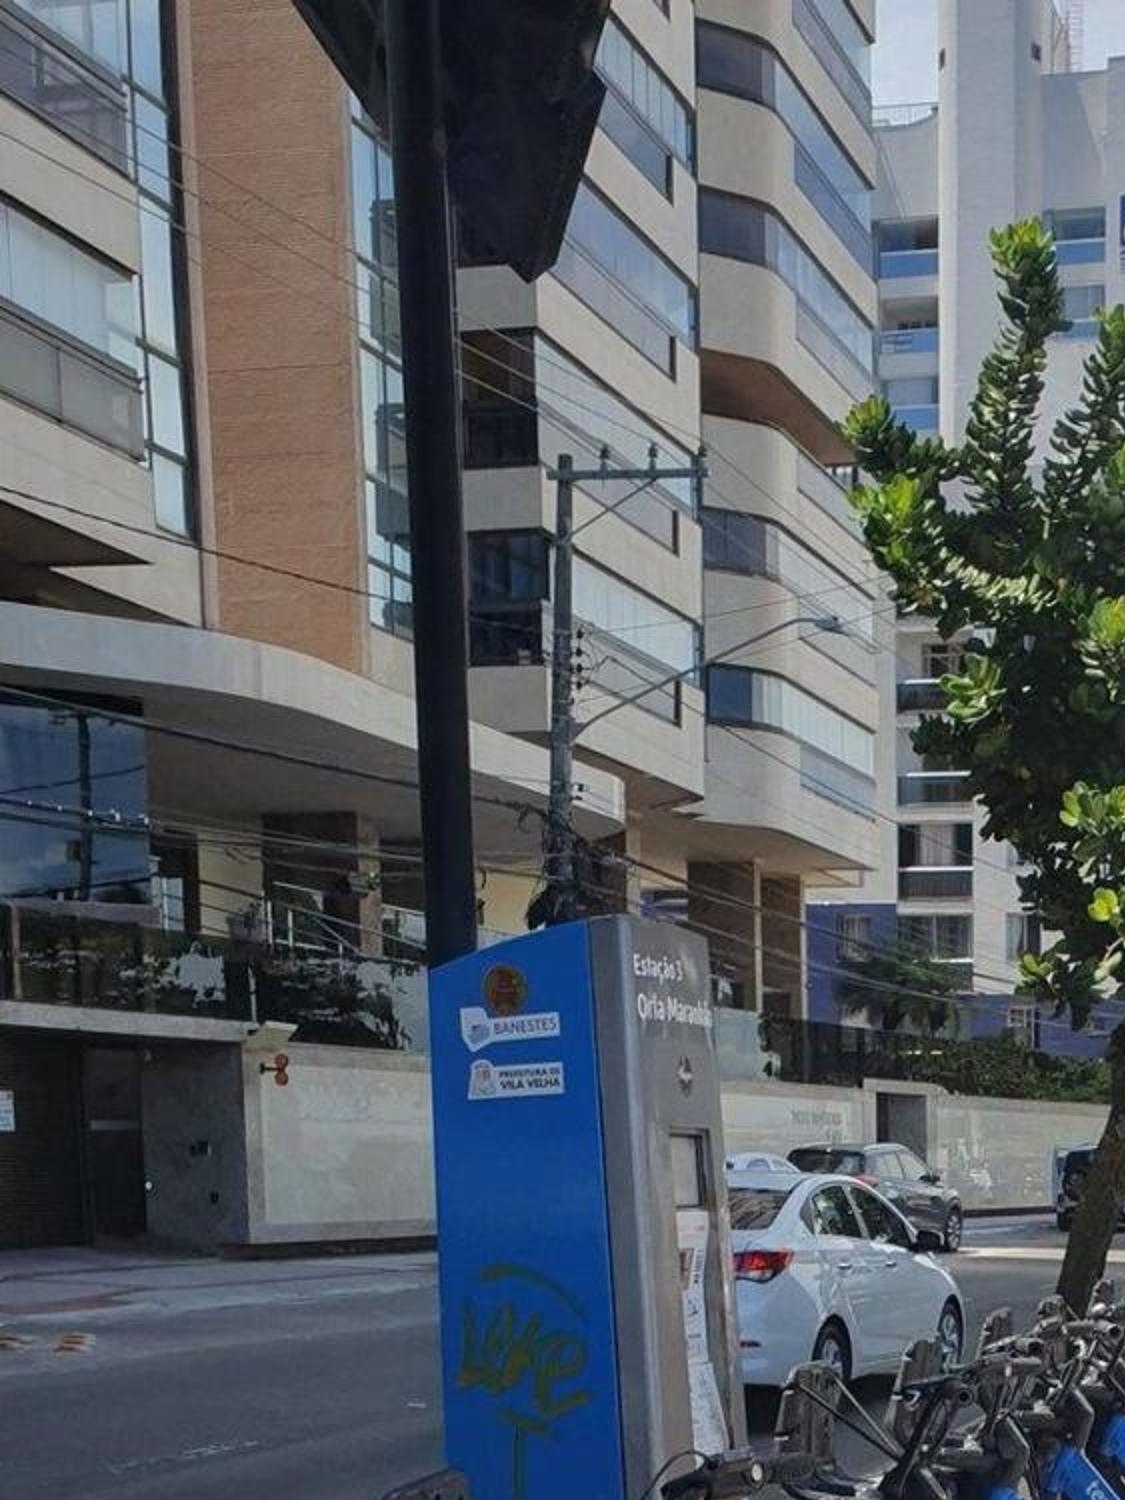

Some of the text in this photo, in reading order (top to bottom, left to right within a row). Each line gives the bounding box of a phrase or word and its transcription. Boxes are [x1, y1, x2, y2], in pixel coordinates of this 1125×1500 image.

[633, 953, 675, 984] Estação
[637, 993, 665, 1020] Orla
[494, 1016, 557, 1036] BANESTES
[500, 1077, 560, 1089] VILA VELHA
